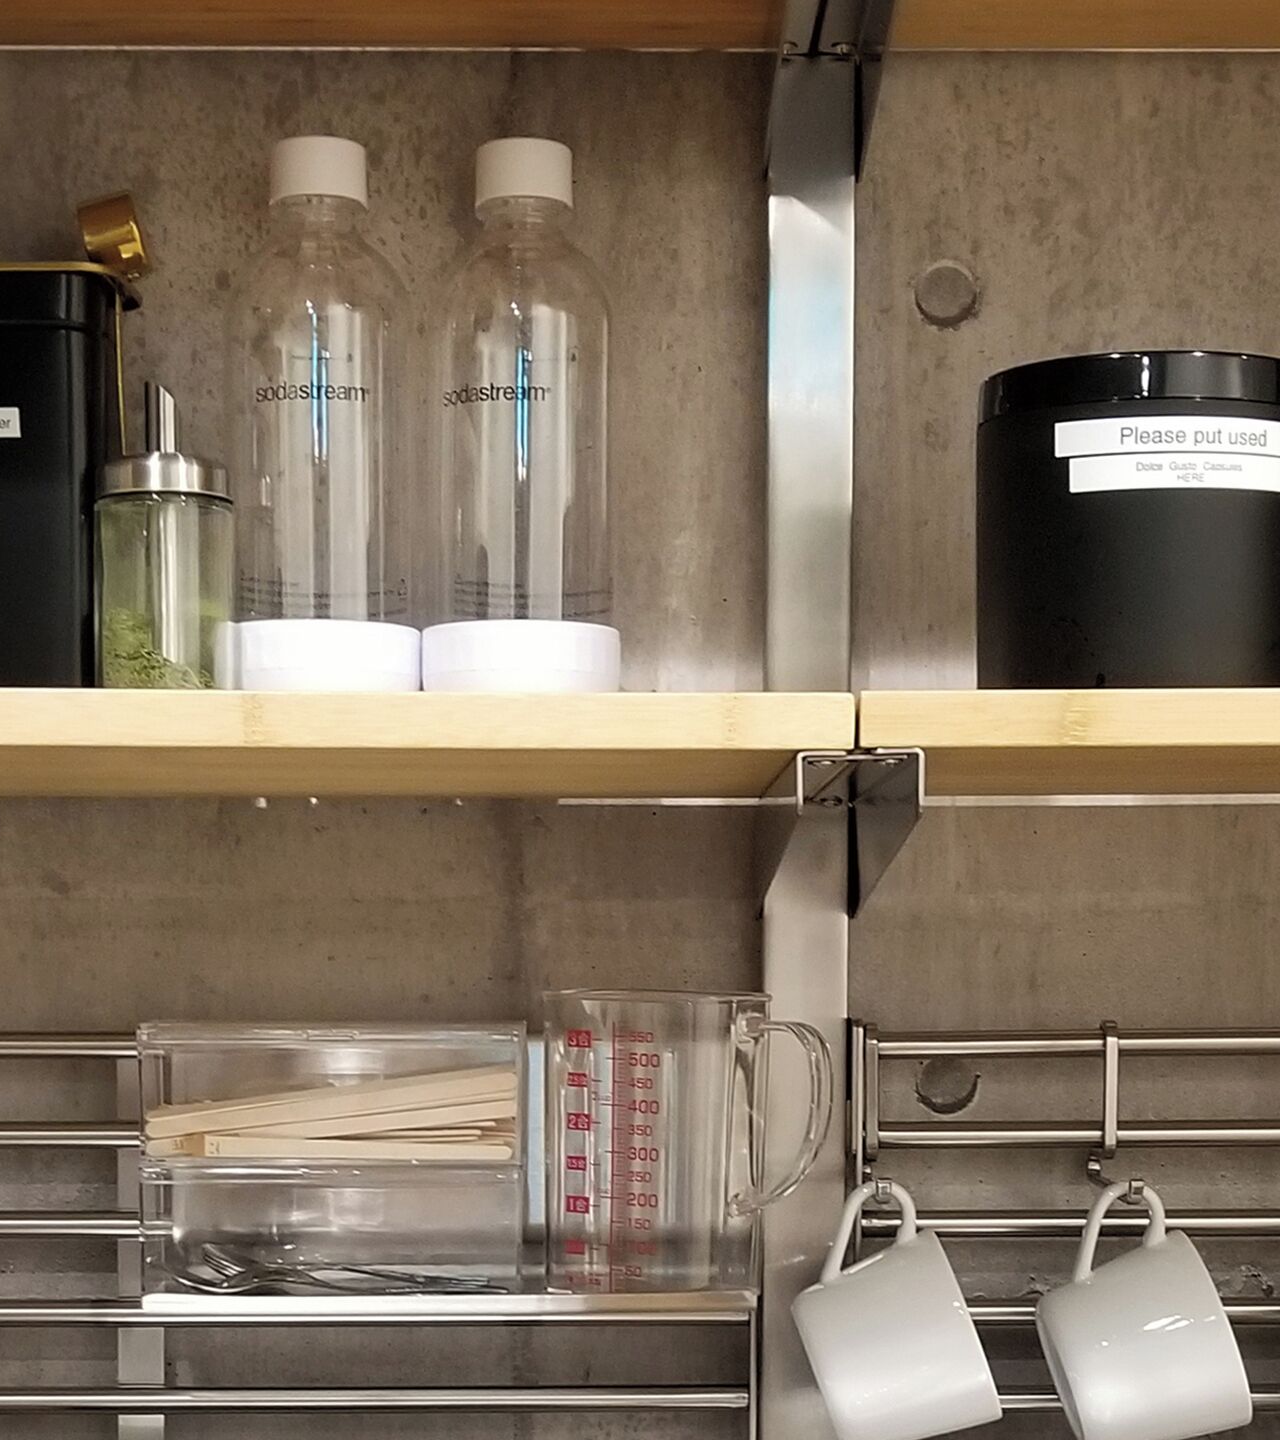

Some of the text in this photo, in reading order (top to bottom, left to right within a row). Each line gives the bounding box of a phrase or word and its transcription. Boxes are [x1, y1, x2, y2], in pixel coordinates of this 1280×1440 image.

[256, 382, 365, 403] sodastream
[443, 382, 546, 407] sodastream
[1120, 427, 1267, 447] Please put used
[1177, 472, 1205, 482] HERE
[628, 1031, 654, 1043] 550
[627, 1052, 660, 1068] 500
[627, 1077, 653, 1090] 450
[626, 1099, 660, 1115] 400
[627, 1124, 653, 1137] 350
[626, 1146, 660, 1162] 300
[627, 1170, 652, 1183] 250
[627, 1192, 658, 1208] 200
[628, 1217, 651, 1231] 150
[625, 1265, 642, 1278] 50
